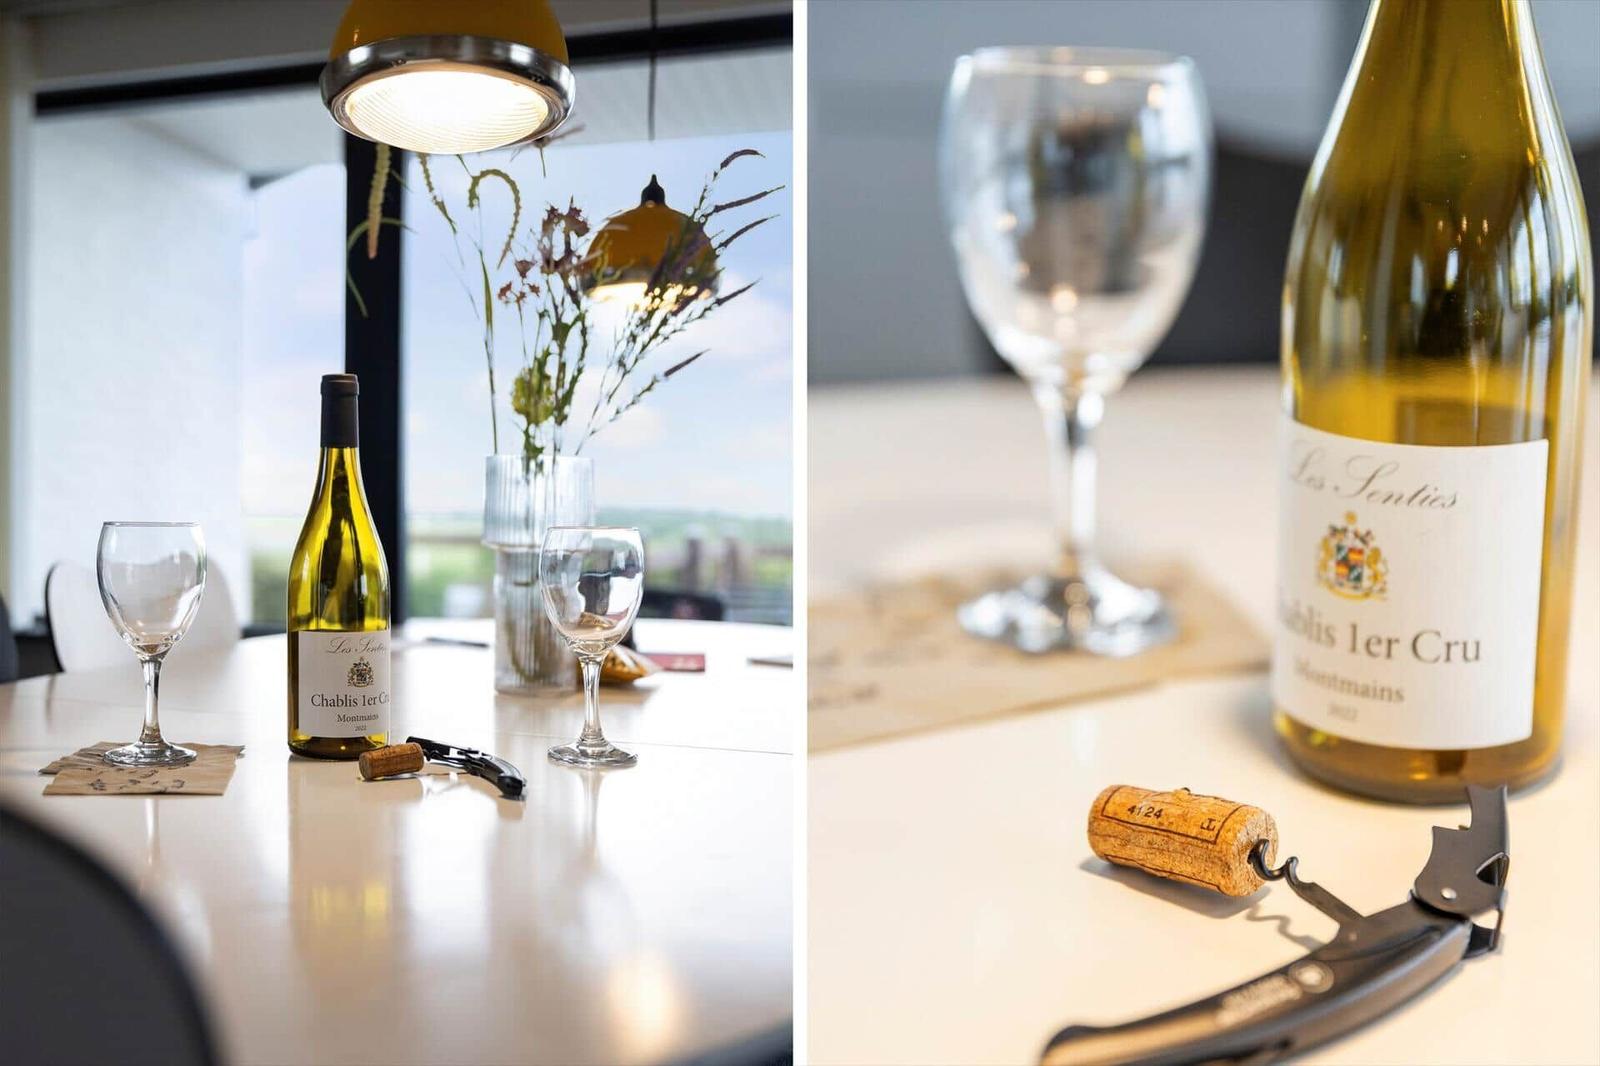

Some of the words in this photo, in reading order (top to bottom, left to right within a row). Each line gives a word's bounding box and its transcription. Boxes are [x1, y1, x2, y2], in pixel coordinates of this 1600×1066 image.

[325, 636, 352, 655] Les
[1349, 622, 1401, 660] 1er
[1411, 629, 1482, 664] Cru
[311, 694, 358, 708] Chablis
[362, 694, 377, 707] 1er
